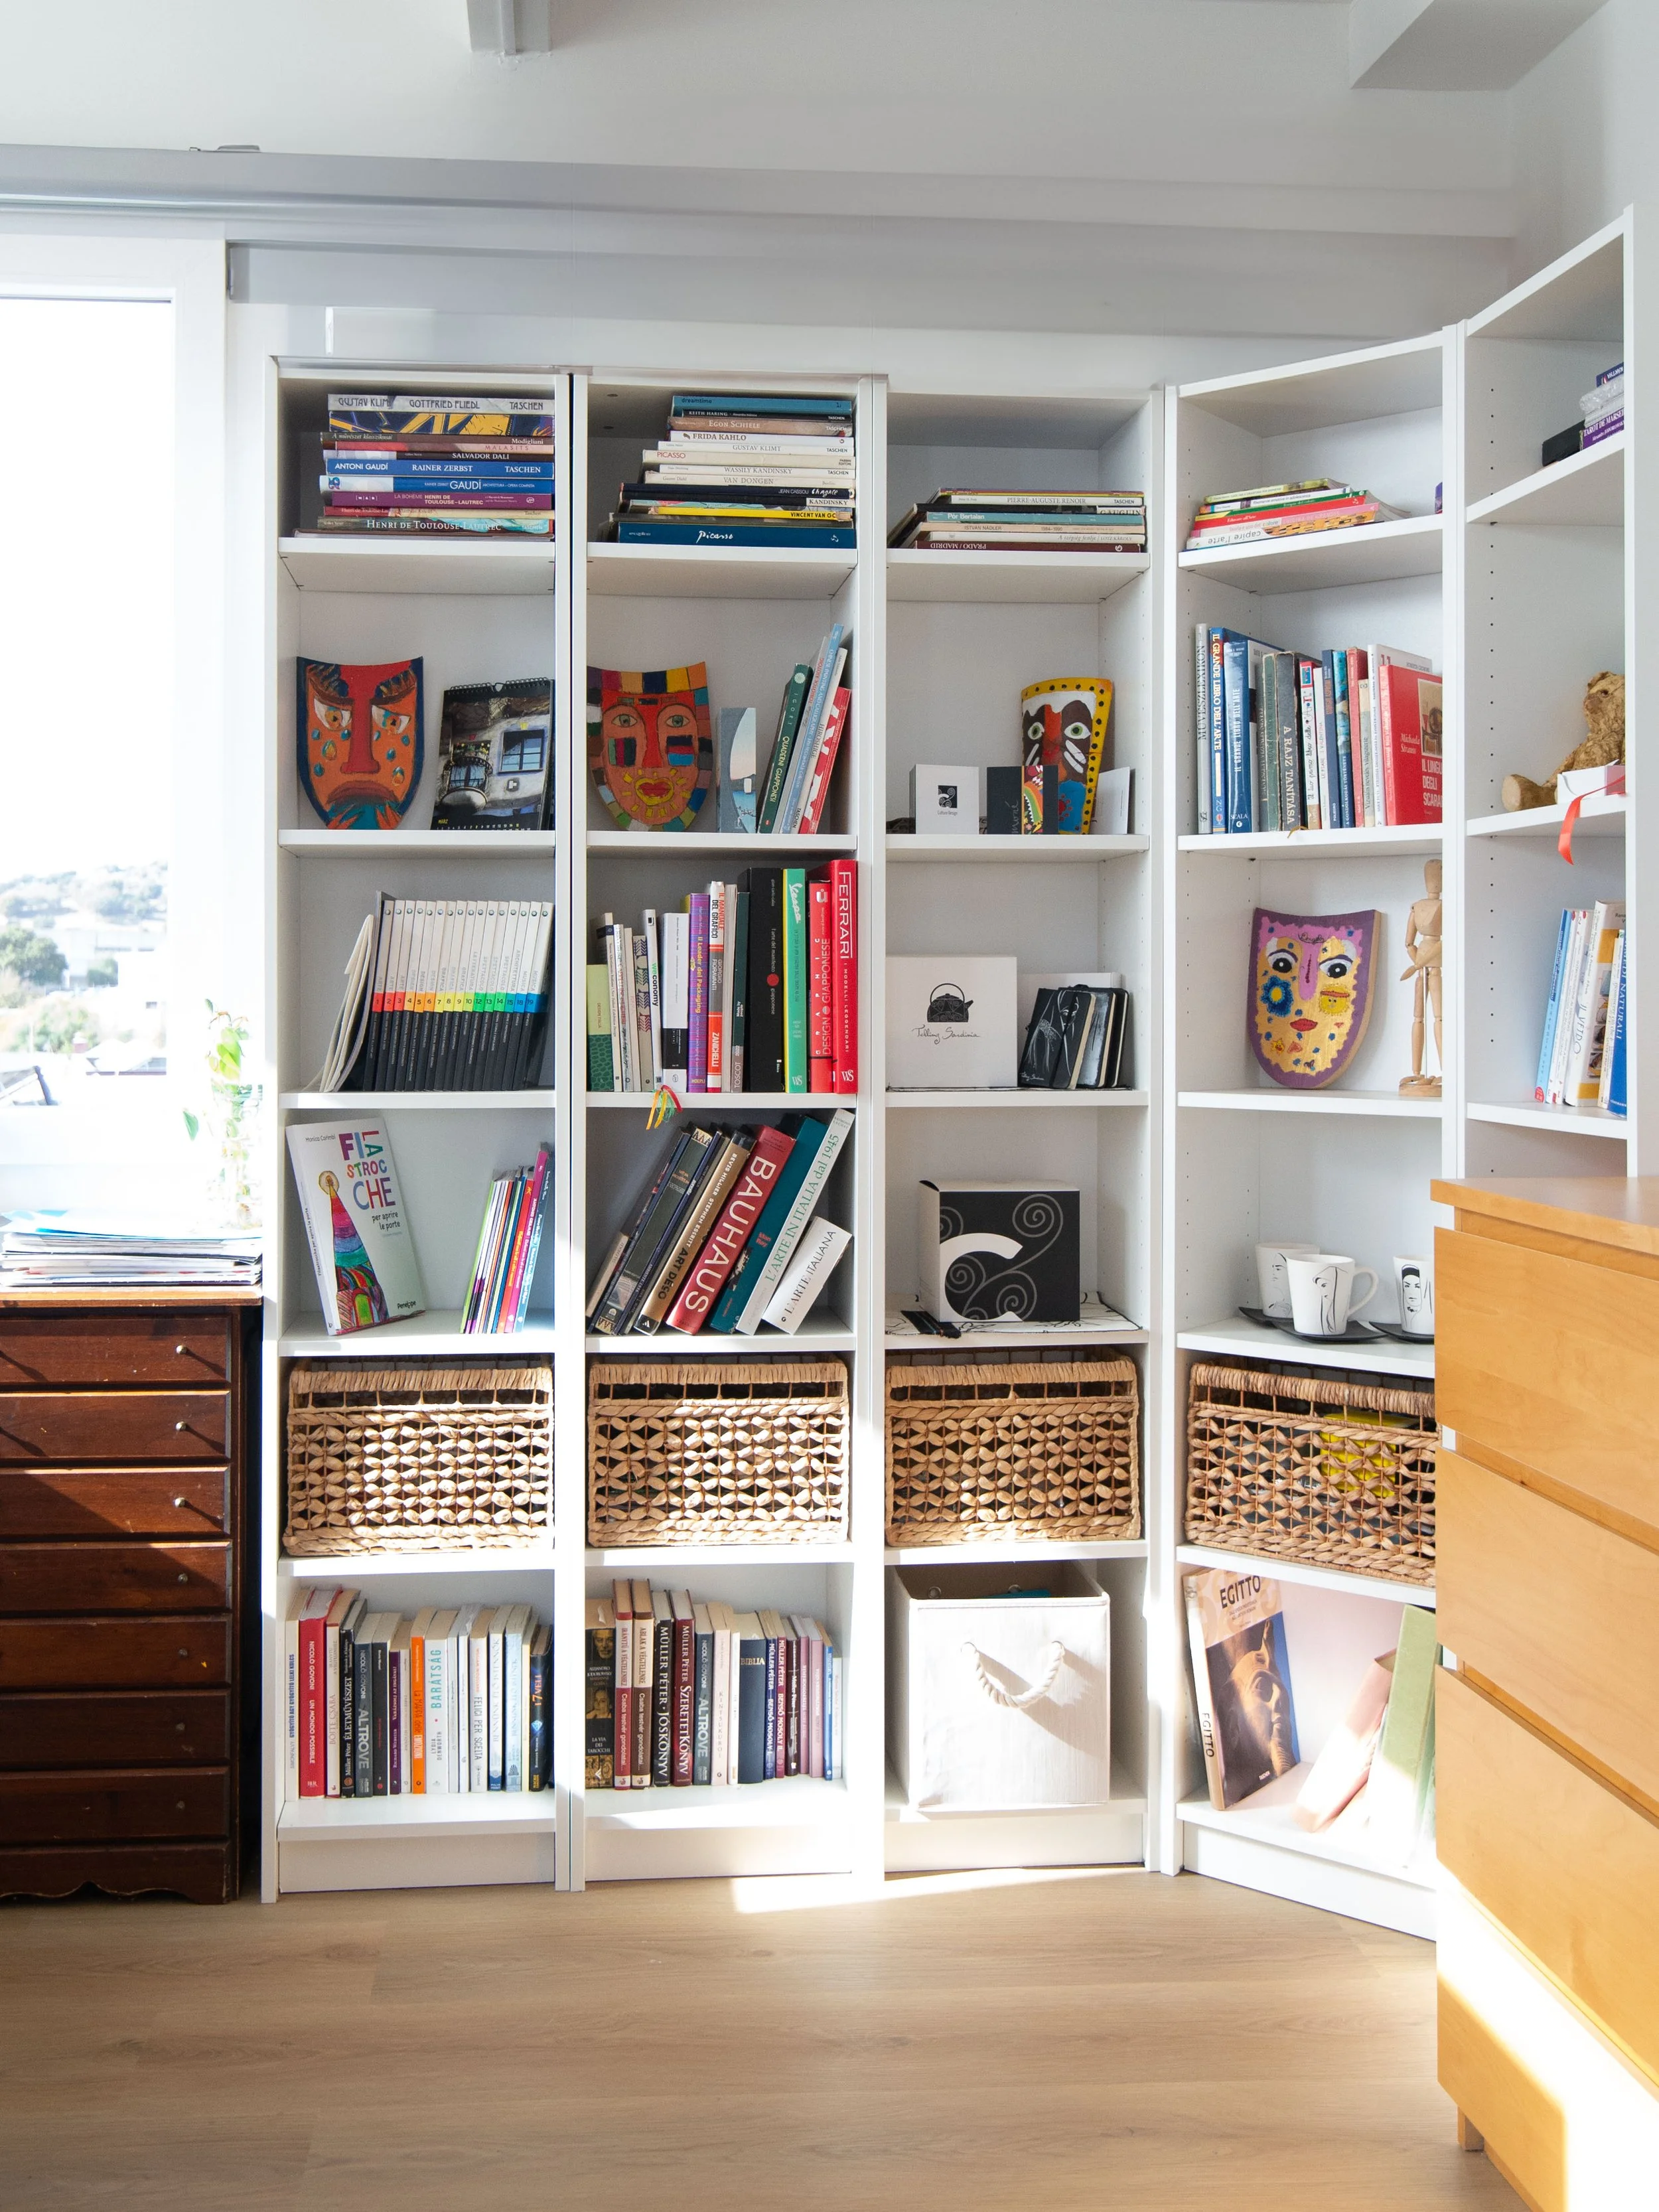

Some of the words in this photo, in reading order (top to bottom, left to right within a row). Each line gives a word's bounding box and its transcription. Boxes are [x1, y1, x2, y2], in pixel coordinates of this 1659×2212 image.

[409, 400, 453, 409] GOTTFRIED
[455, 400, 480, 409] FLIEDL
[450, 479, 481, 489] GAUDÍ
[1234, 531, 1261, 541] capire
[1212, 643, 1221, 678] GRANDE
[811, 723, 825, 759] HIROSHIGE
[1214, 707, 1222, 750] DELL'ARTE
[778, 736, 790, 769] QUADERNI
[770, 769, 782, 802] GIAPPONESI
[1286, 770, 1296, 824] TANÍTÁSA
[1423, 775, 1437, 788] DEGLI
[792, 808, 802, 828] TASCHEN
[789, 883, 803, 924] Vespa
[839, 871, 853, 958] FERRARI
[912, 1024, 940, 1045] Telling
[942, 1027, 979, 1039] Sardinia
[347, 1159, 387, 1179] STROC
[725, 1153, 737, 1172] BEVIS
[353, 1177, 396, 1210] CHE
[713, 1172, 727, 1196] HILLIER
[382, 1211, 398, 1221] aprire
[699, 1198, 714, 1226] STEPHEN
[765, 1238, 791, 1283] L'ARTE
[785, 1222, 799, 1240] IN
[793, 1181, 819, 1222] ITALIA
[814, 1159, 828, 1179] dal
[822, 1134, 839, 1159] 1945
[386, 1221, 400, 1231] porte
[685, 1155, 776, 1313] BAUHAUS
[674, 1248, 688, 1273] ART
[784, 1275, 811, 1315] L'ARTE
[806, 1230, 836, 1275] ITALIANA
[1220, 1576, 1260, 1609] EGITTO
[660, 1627, 669, 1669] MÜLLER
[740, 1657, 765, 1666] BIBLIA
[429, 1650, 441, 1708] BARÁTSÁG
[682, 1659, 691, 1682] PÉTER
[659, 1673, 669, 1704] PÉTER
[474, 1697, 482, 1716] FELICI
[359, 1709, 369, 1769] ALTROVE
[698, 1698, 709, 1757] ALTROVE
[1201, 1712, 1215, 1758] EGITTO
[656, 1712, 670, 1777] JÓSKÖNYV
